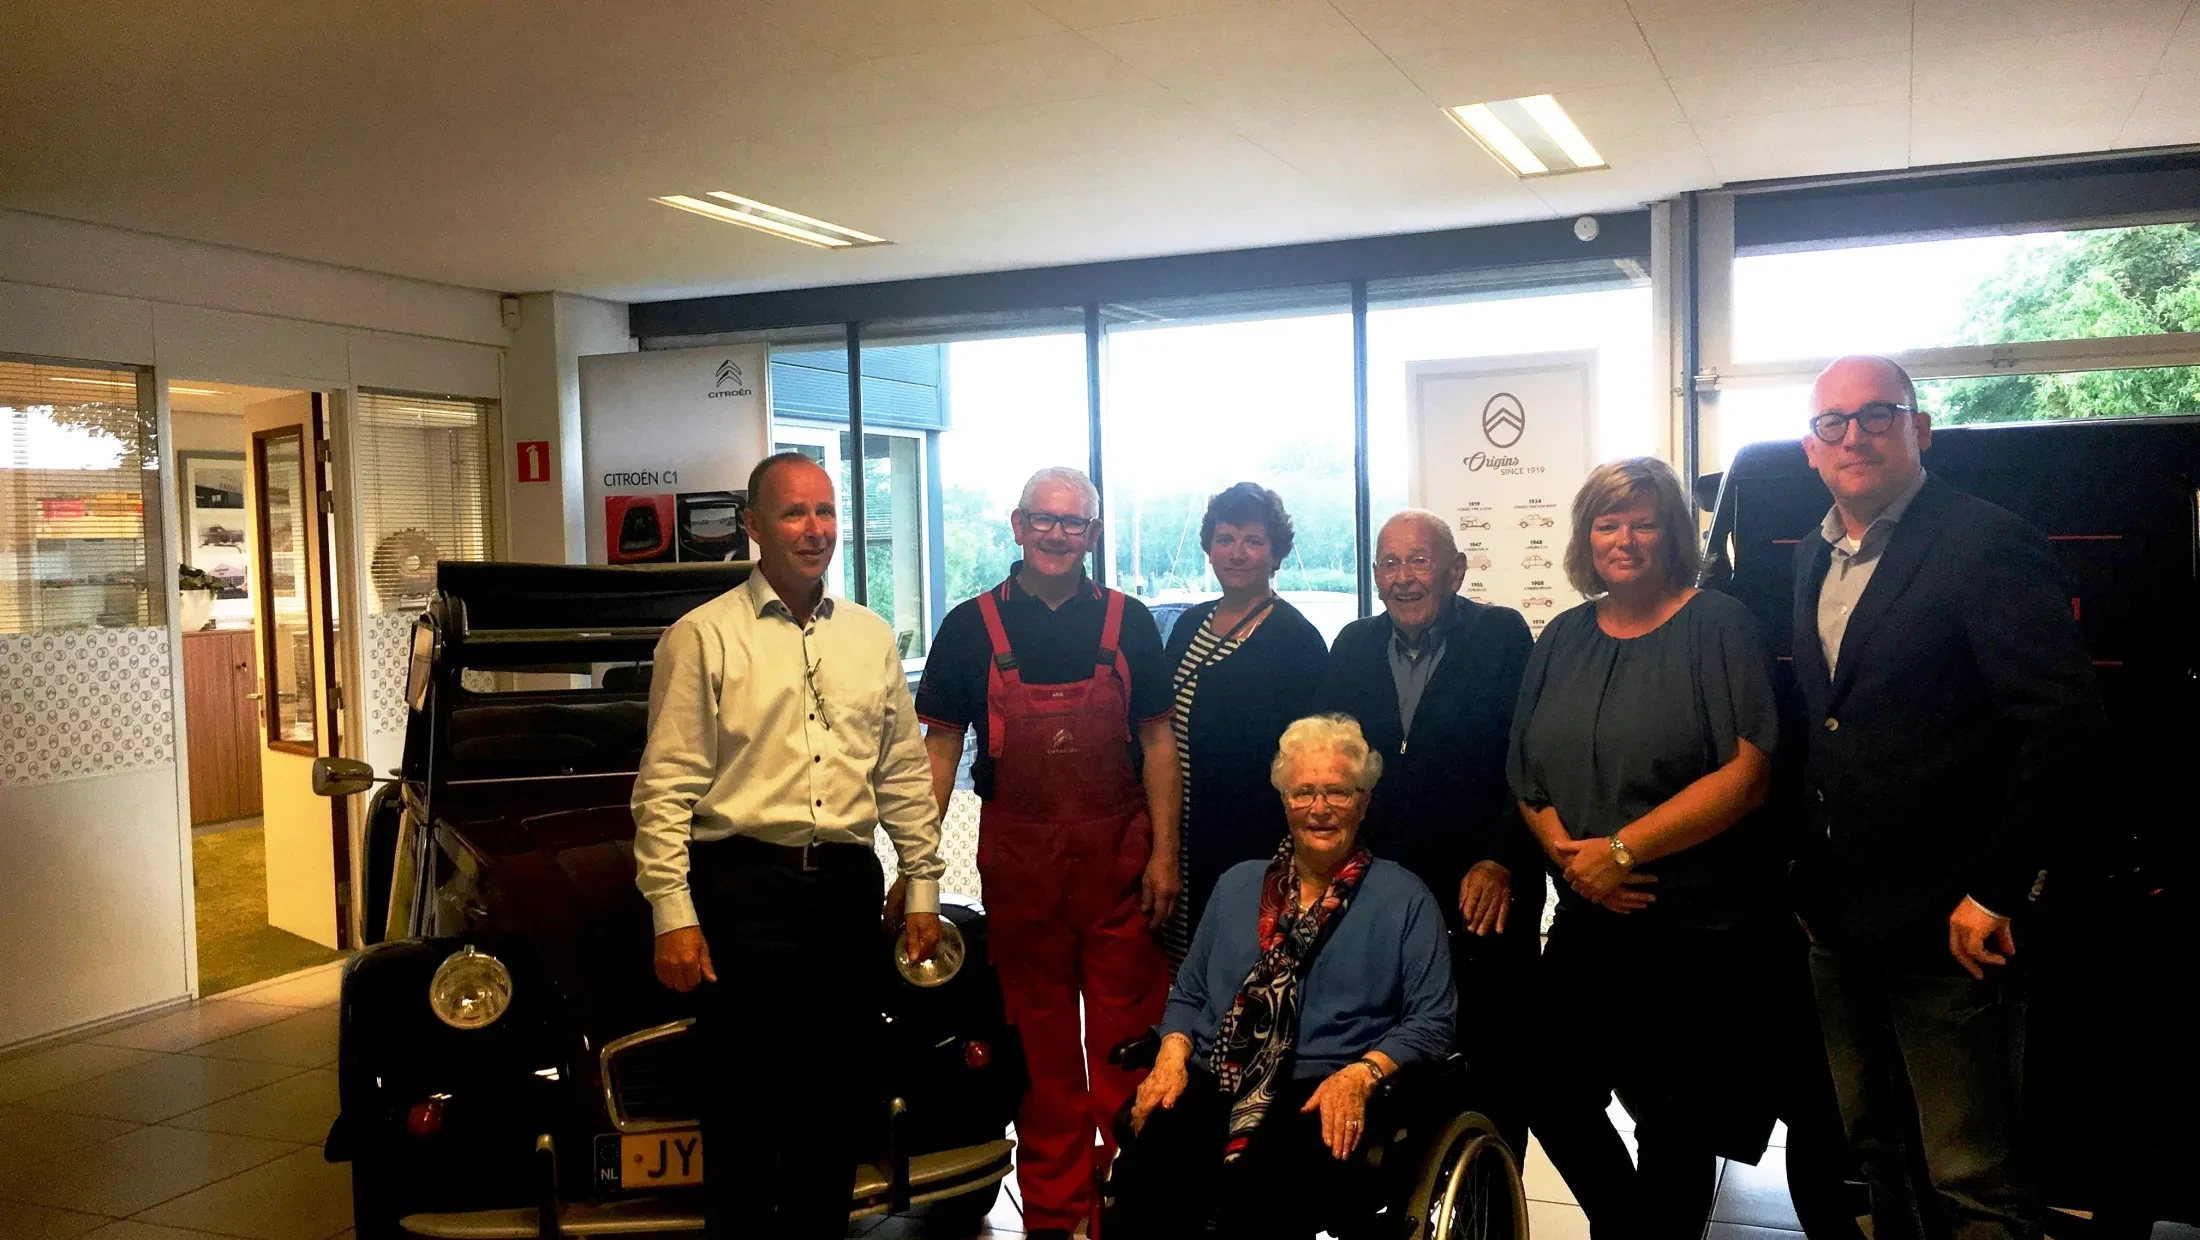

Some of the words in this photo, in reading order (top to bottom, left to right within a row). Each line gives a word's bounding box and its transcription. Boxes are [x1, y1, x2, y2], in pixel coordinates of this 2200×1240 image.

[1463, 451, 1520, 472] Origins
[603, 468, 659, 487] CITROËN
[662, 470, 678, 484] C1
[1500, 467, 1525, 476] SINCE
[1527, 466, 1545, 474] 1919
[600, 1168, 619, 1180] NL
